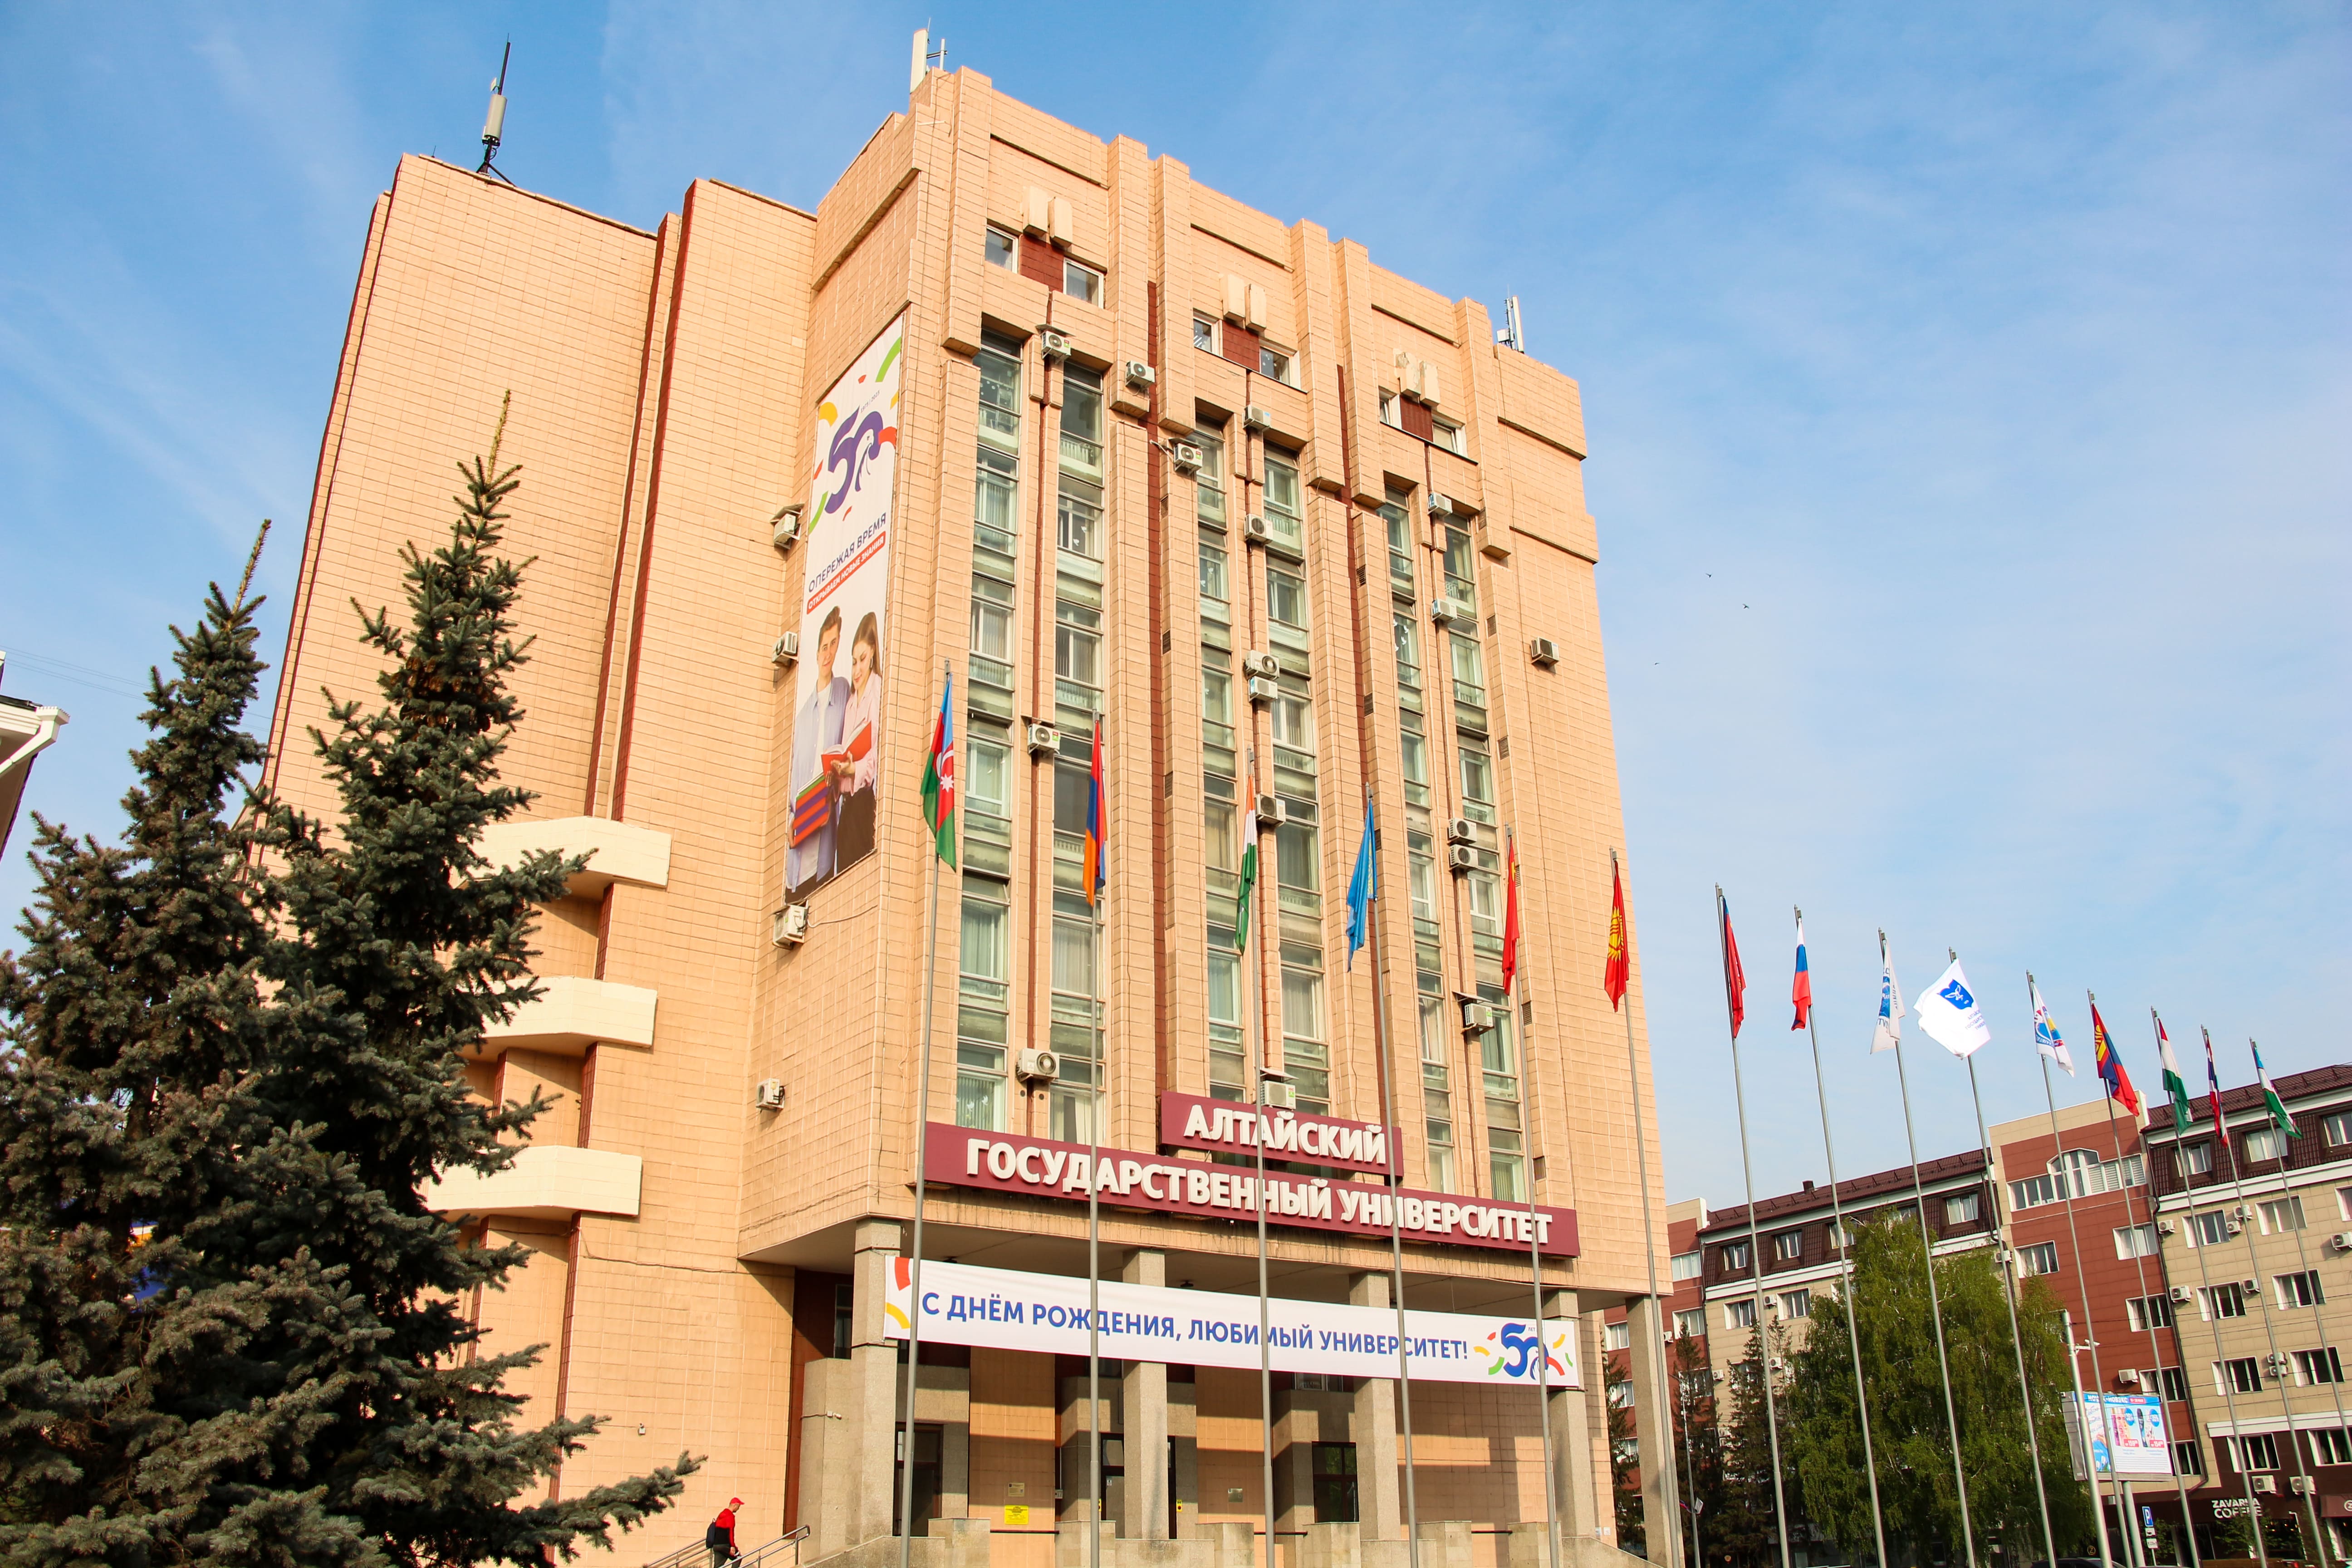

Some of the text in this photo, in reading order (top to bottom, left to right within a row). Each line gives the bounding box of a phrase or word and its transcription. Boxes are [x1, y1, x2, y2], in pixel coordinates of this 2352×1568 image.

[808, 512, 886, 593] ОПЕРЕЖАЯ ВРЕМЯ
[808, 536, 884, 609] ОТКРЫВАЕМ НОВЫЕ ЗНАНИЯ
[1183, 1104, 1387, 1165] АЛТАЙСКИЙ
[966, 1138, 1553, 1245] ГОСУДАРСТВЕННЫЙ УНИВЕРСИТЕТ
[922, 1292, 1468, 1360] С ДНЁМ РОЖДЕНИЯ, ЛЮБИМЫЙ УНИВЕРСИТЕТ!
